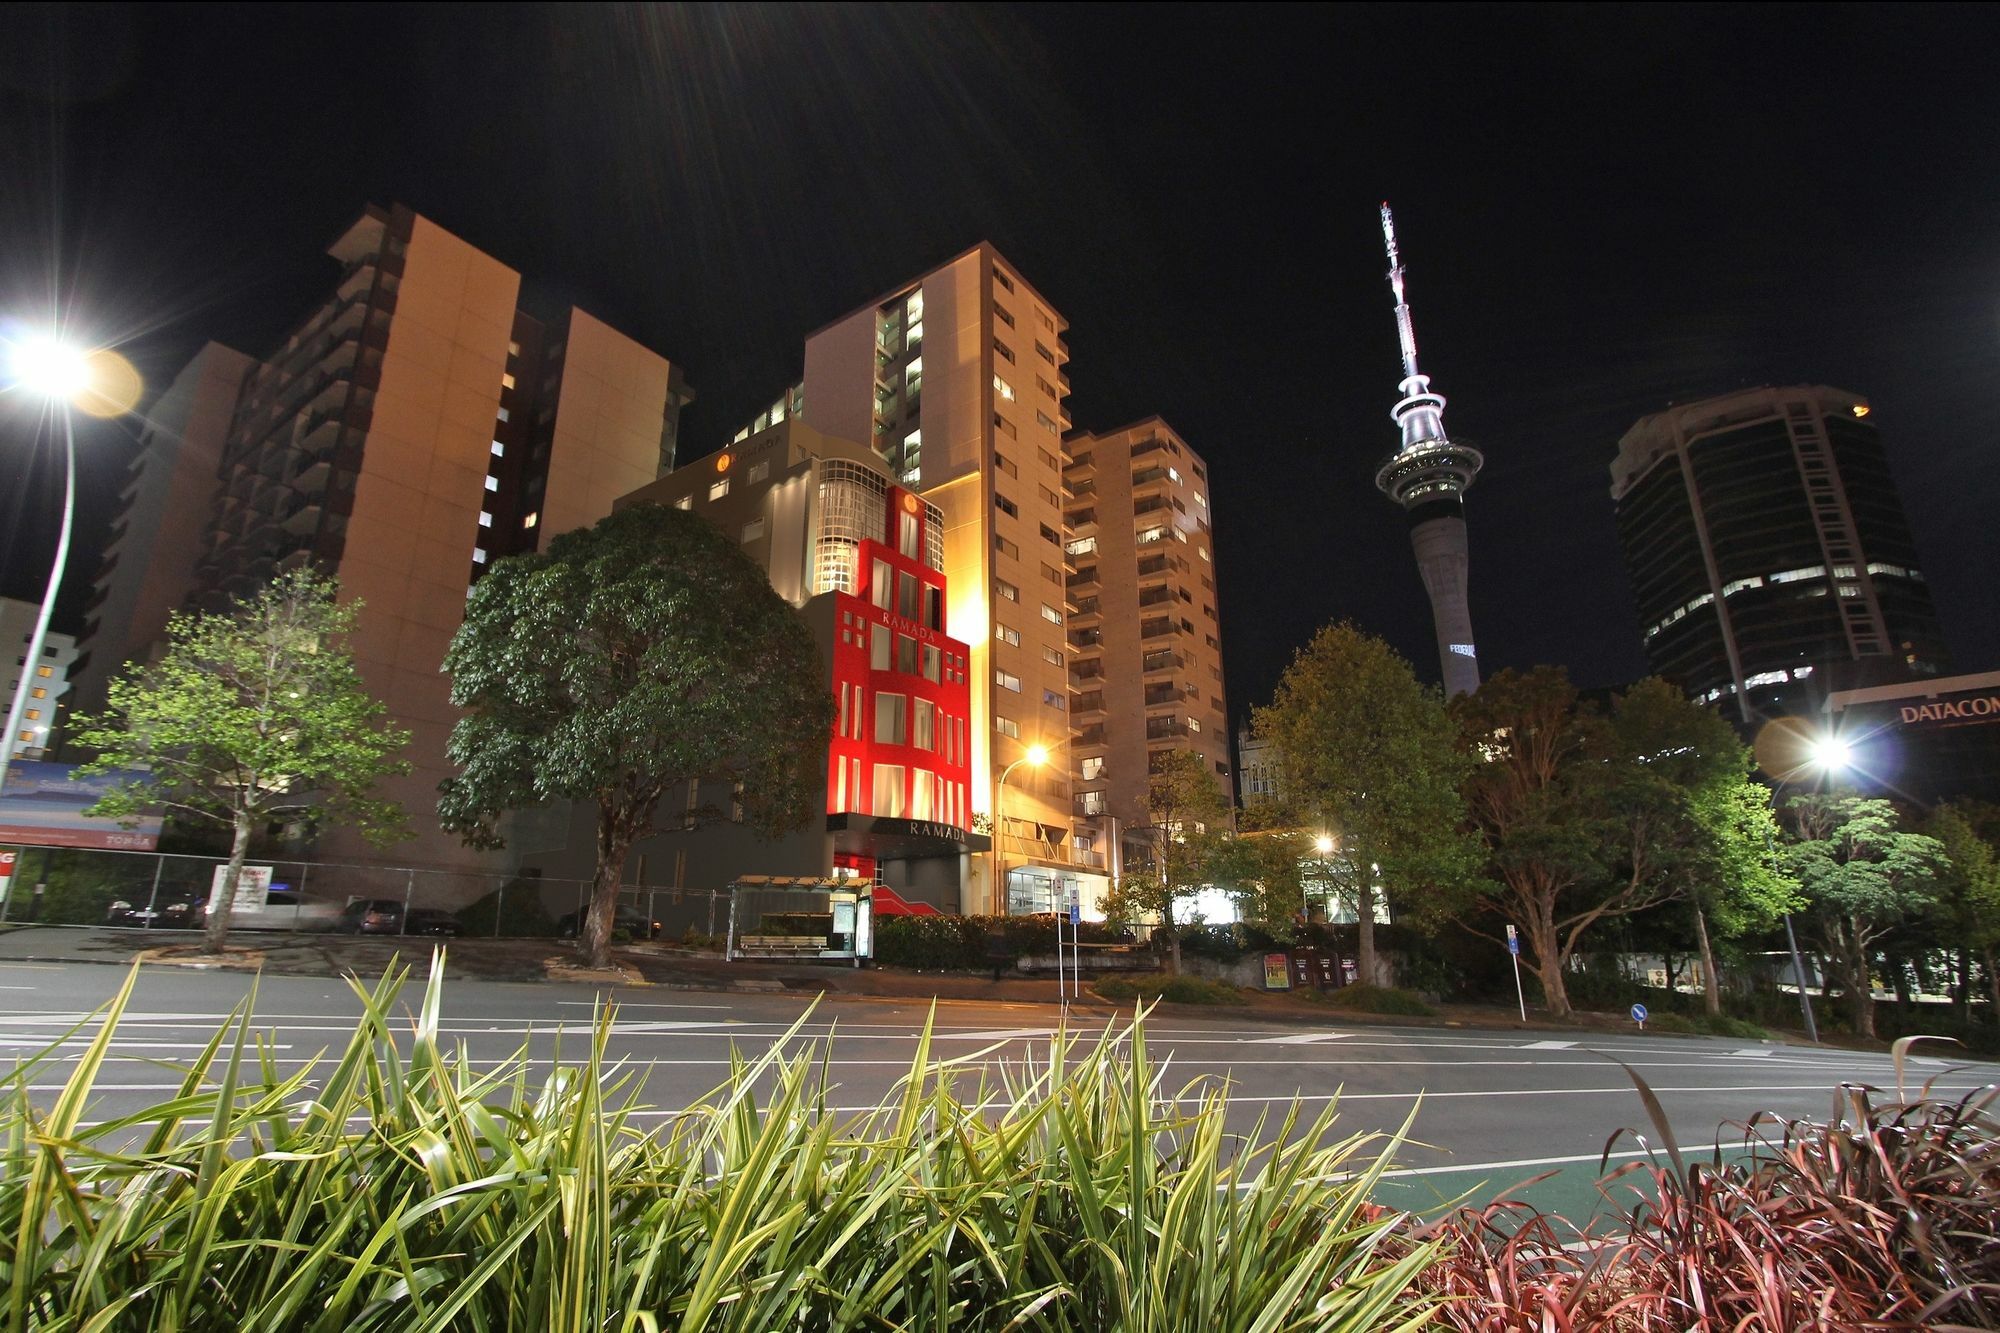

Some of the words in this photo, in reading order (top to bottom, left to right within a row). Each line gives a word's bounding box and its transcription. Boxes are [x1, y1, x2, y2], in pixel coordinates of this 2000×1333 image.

[883, 612, 935, 642] RAMADA
[106, 835, 150, 846] TONGA
[910, 821, 965, 843] RAMADA
